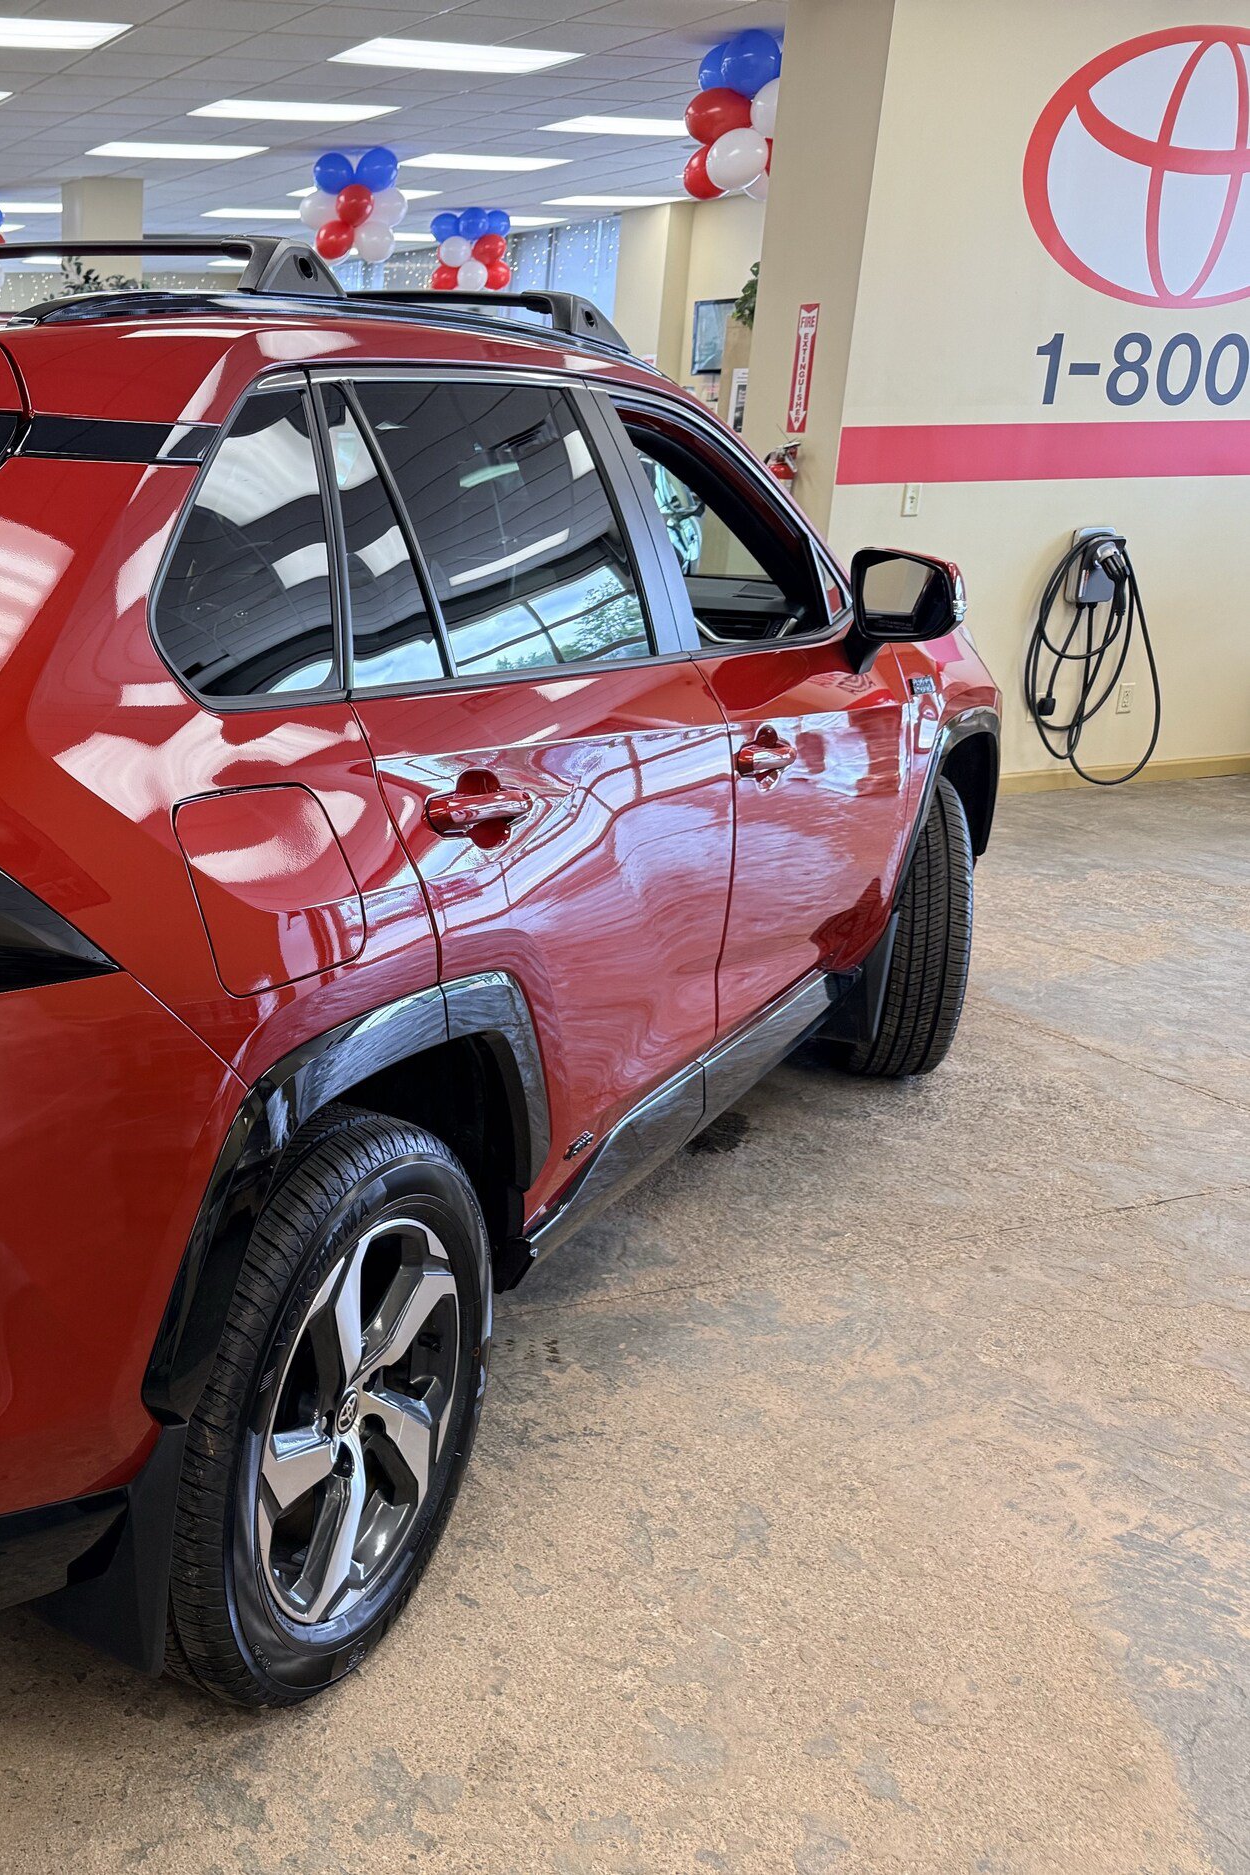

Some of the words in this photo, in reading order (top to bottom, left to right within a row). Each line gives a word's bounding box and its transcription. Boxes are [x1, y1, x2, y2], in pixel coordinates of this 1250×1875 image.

[800, 315, 816, 328] FIRE
[794, 332, 810, 423] EXTINGUISHER
[1036, 332, 1249, 406] 1-800
[274, 1199, 370, 1346] YOKOHAMA
